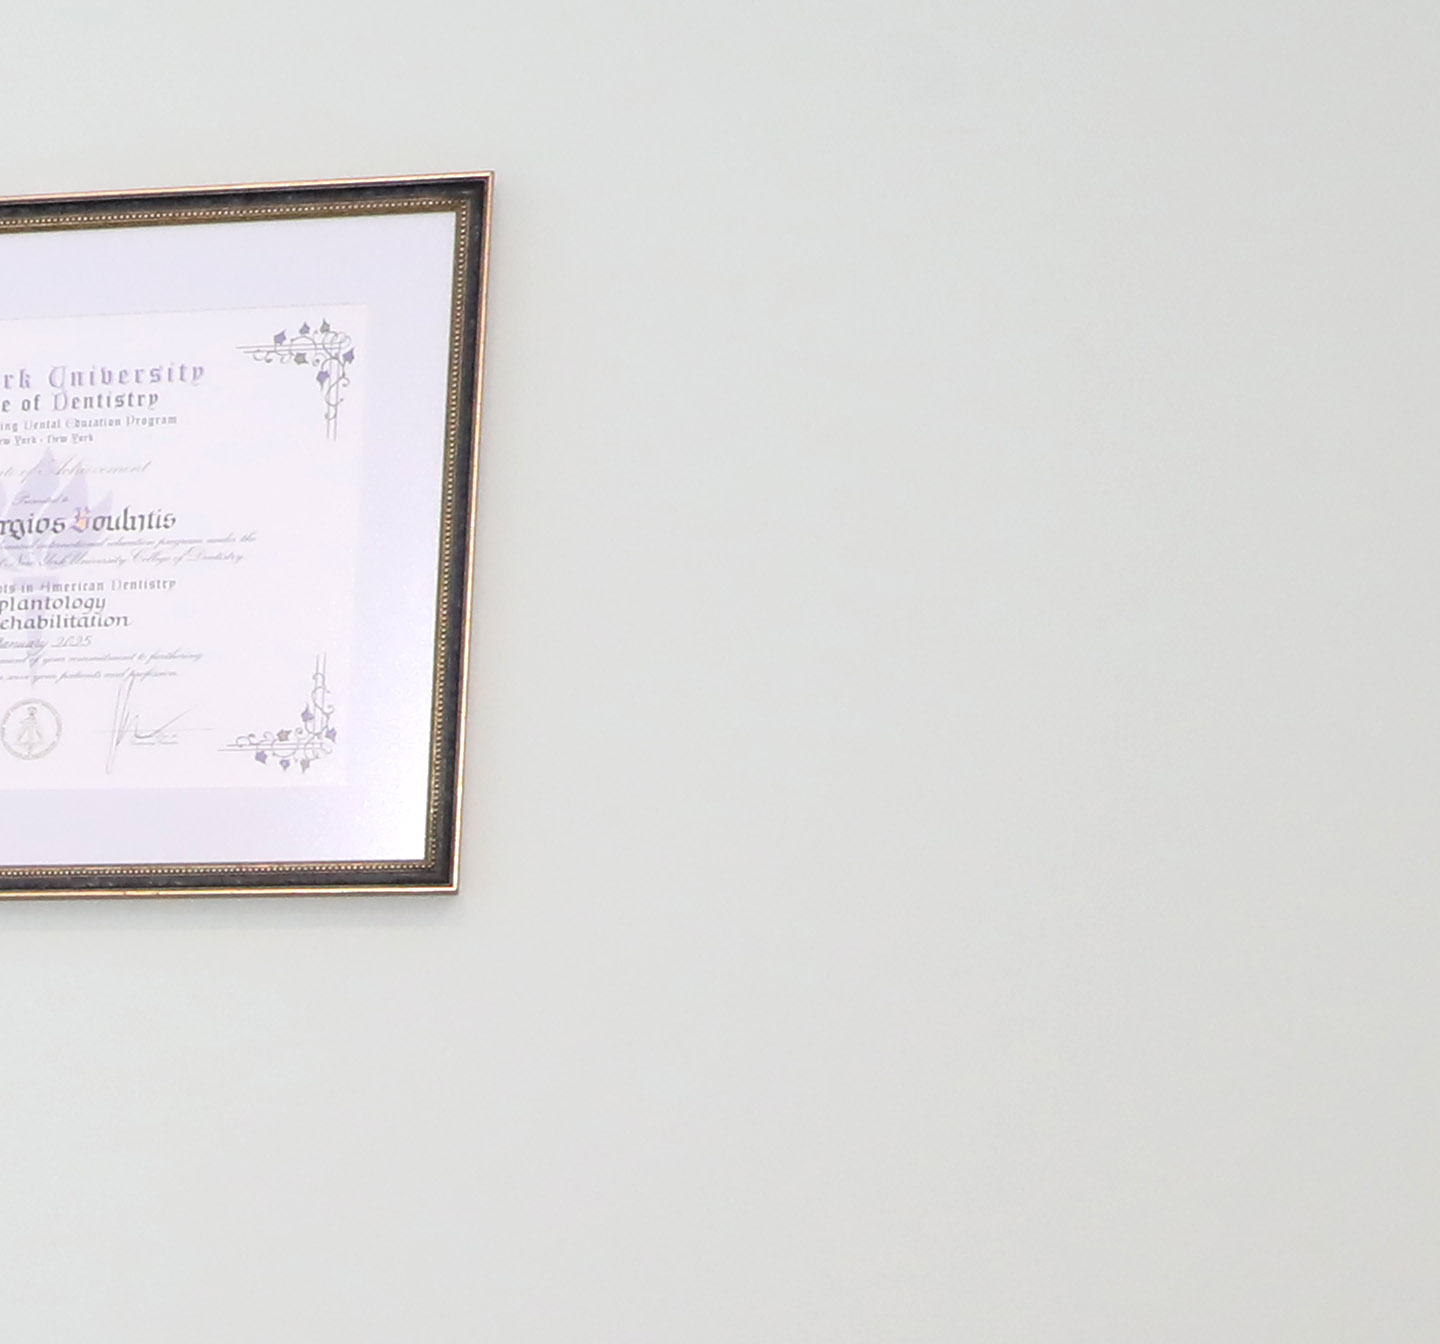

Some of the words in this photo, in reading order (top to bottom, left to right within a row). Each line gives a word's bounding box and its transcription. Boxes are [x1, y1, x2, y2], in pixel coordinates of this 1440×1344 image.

[48, 363, 205, 389] University
[21, 394, 41, 411] of
[53, 390, 159, 411] Dentistry
